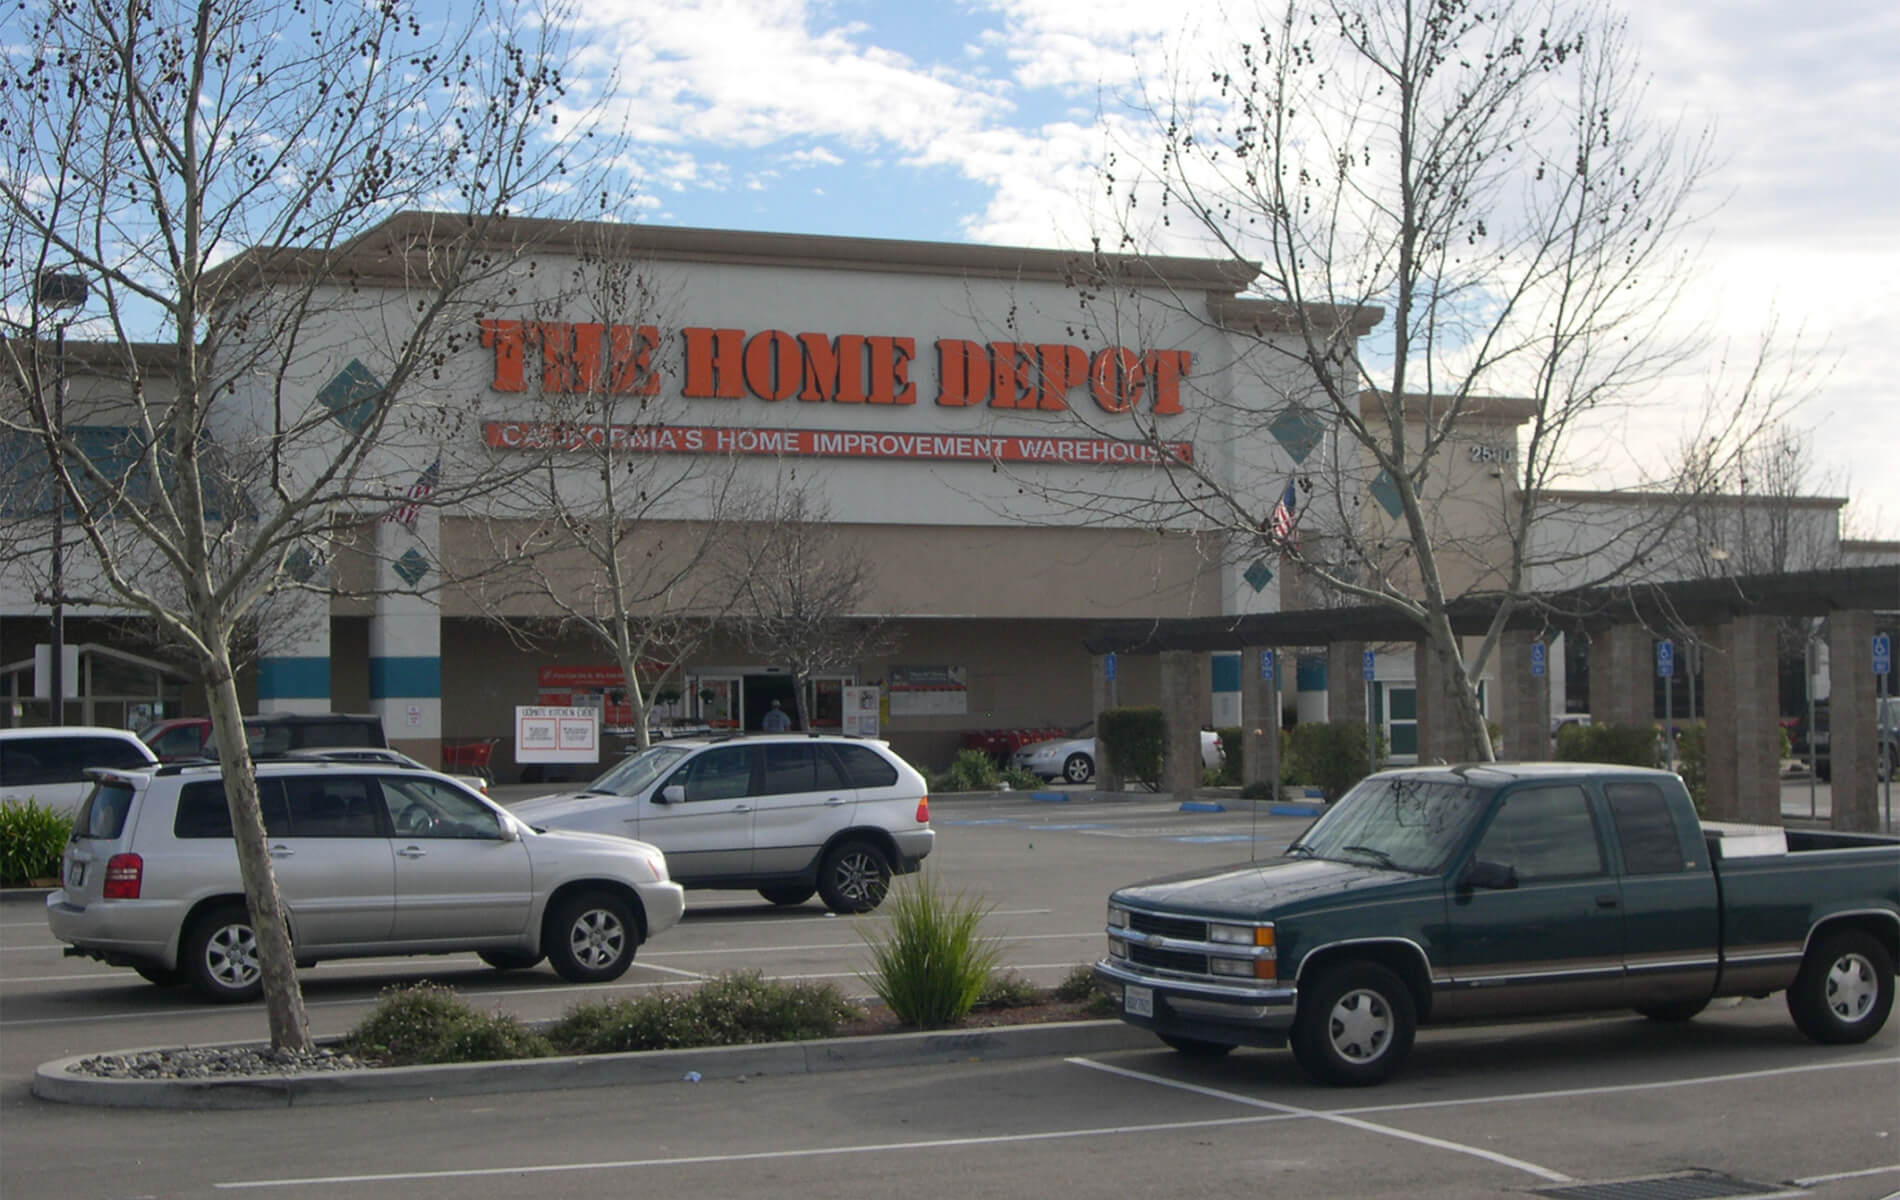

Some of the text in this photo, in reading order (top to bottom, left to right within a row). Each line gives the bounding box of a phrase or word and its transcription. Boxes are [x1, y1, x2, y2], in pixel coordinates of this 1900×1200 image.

[480, 319, 1192, 415] THE HOME DEPOT
[717, 430, 800, 452] HOME
[813, 433, 1007, 458] IMPROVEMENT
